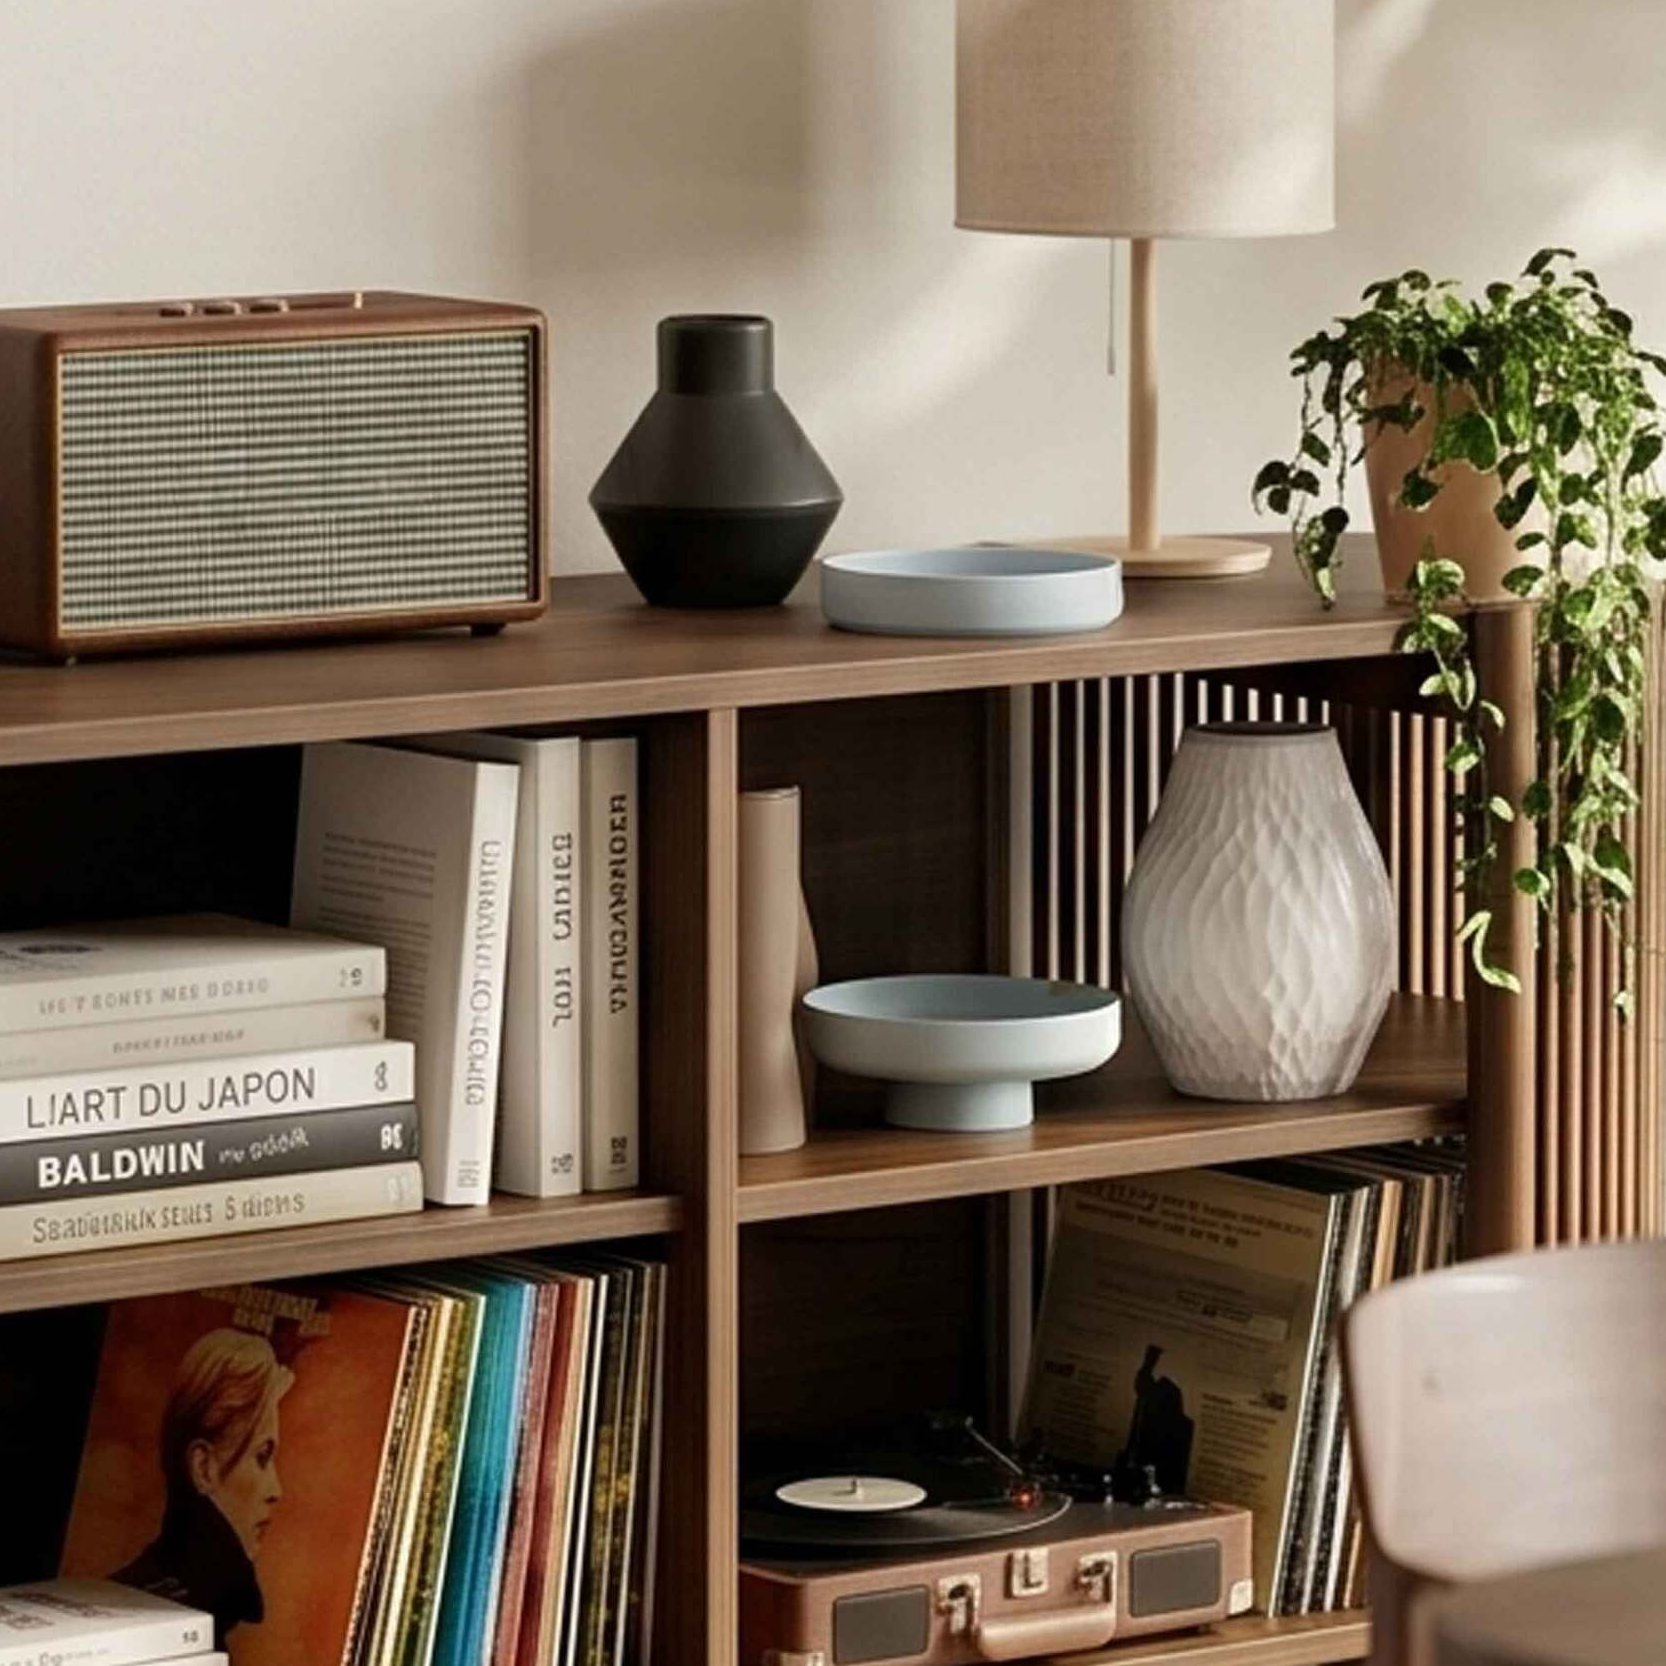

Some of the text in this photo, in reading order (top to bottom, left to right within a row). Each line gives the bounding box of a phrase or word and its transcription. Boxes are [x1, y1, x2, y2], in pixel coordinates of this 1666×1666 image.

[139, 1080, 186, 1117] DU
[198, 1067, 316, 1112] JAPON
[37, 1140, 206, 1189] BALDWIN
